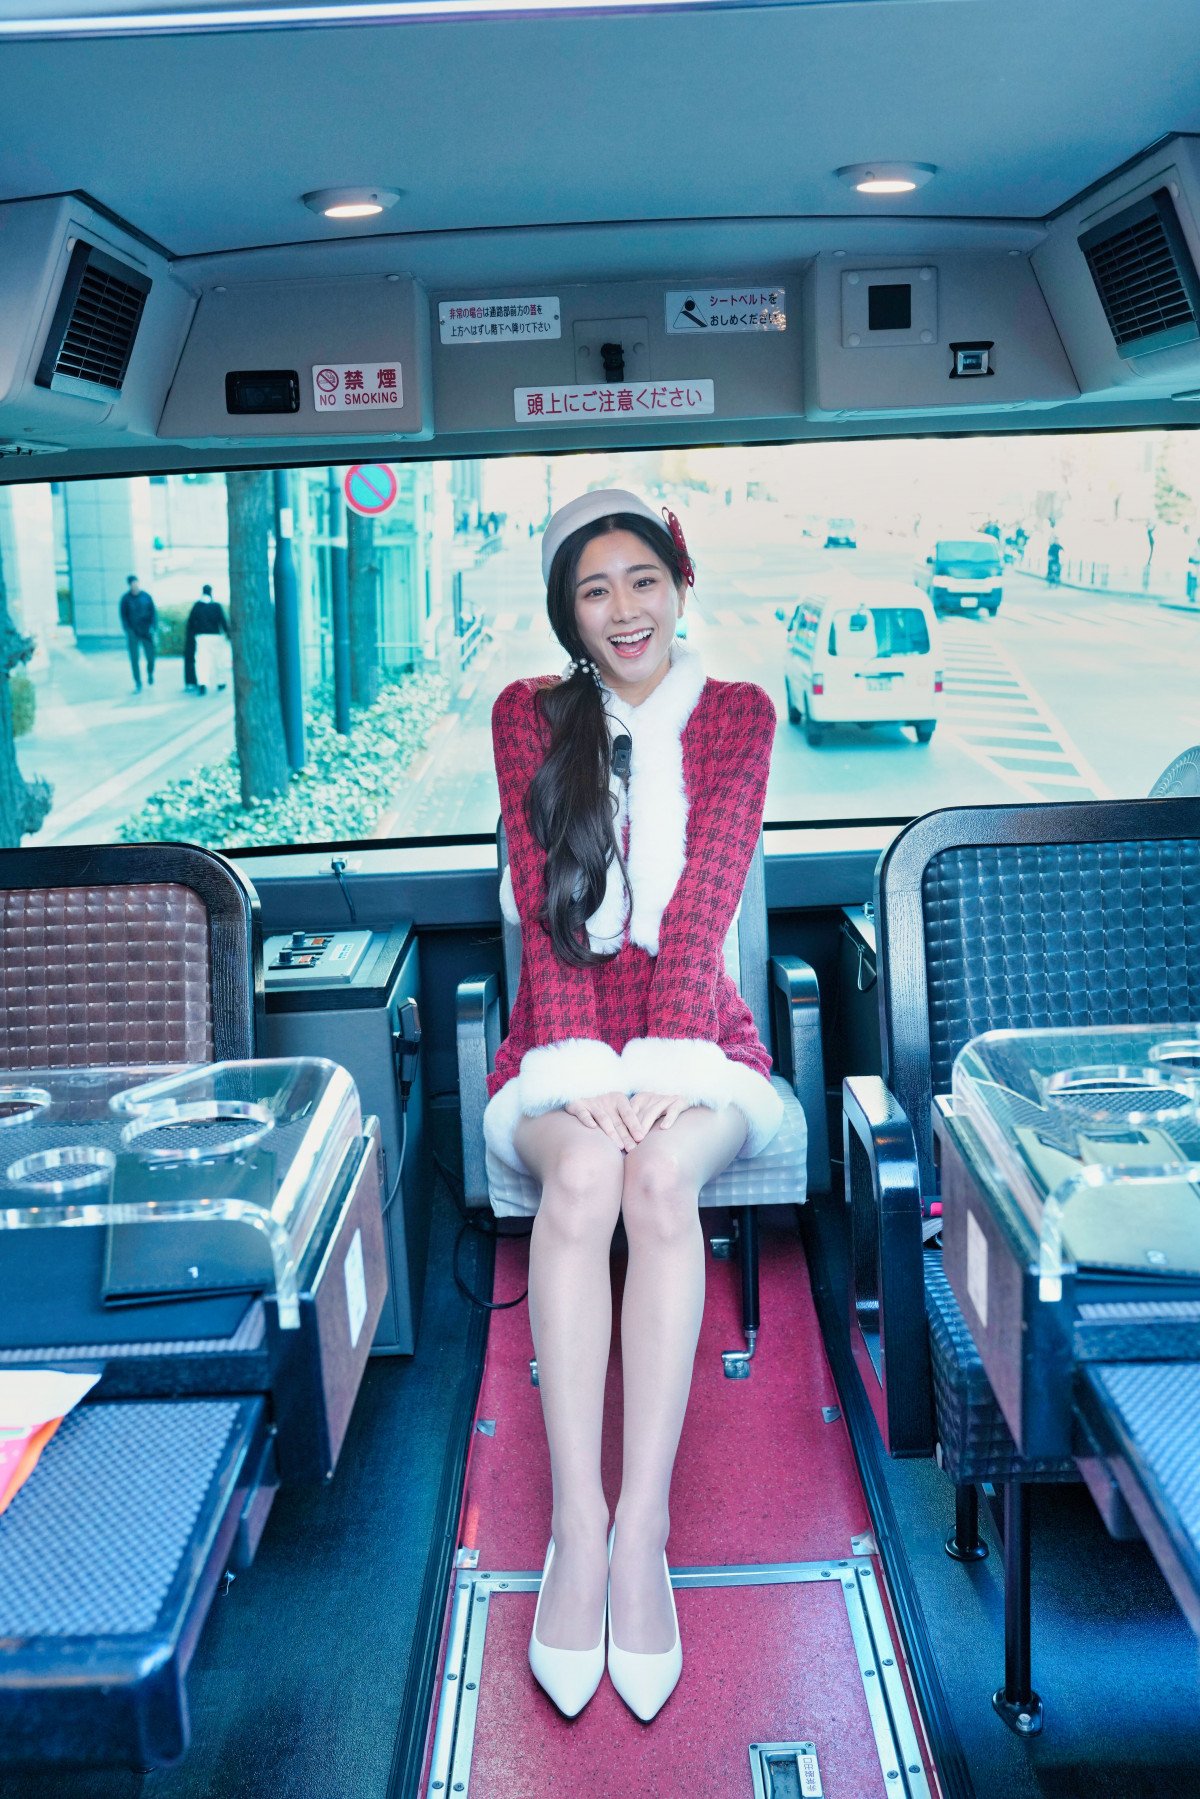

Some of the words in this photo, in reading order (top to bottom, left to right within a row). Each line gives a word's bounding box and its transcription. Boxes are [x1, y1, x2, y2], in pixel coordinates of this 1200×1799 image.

[710, 293, 778, 307] シートベルトを
[319, 394, 336, 406] NO
[344, 391, 398, 405] SMOKING
[526, 386, 703, 416] 頭上にご注意ください
